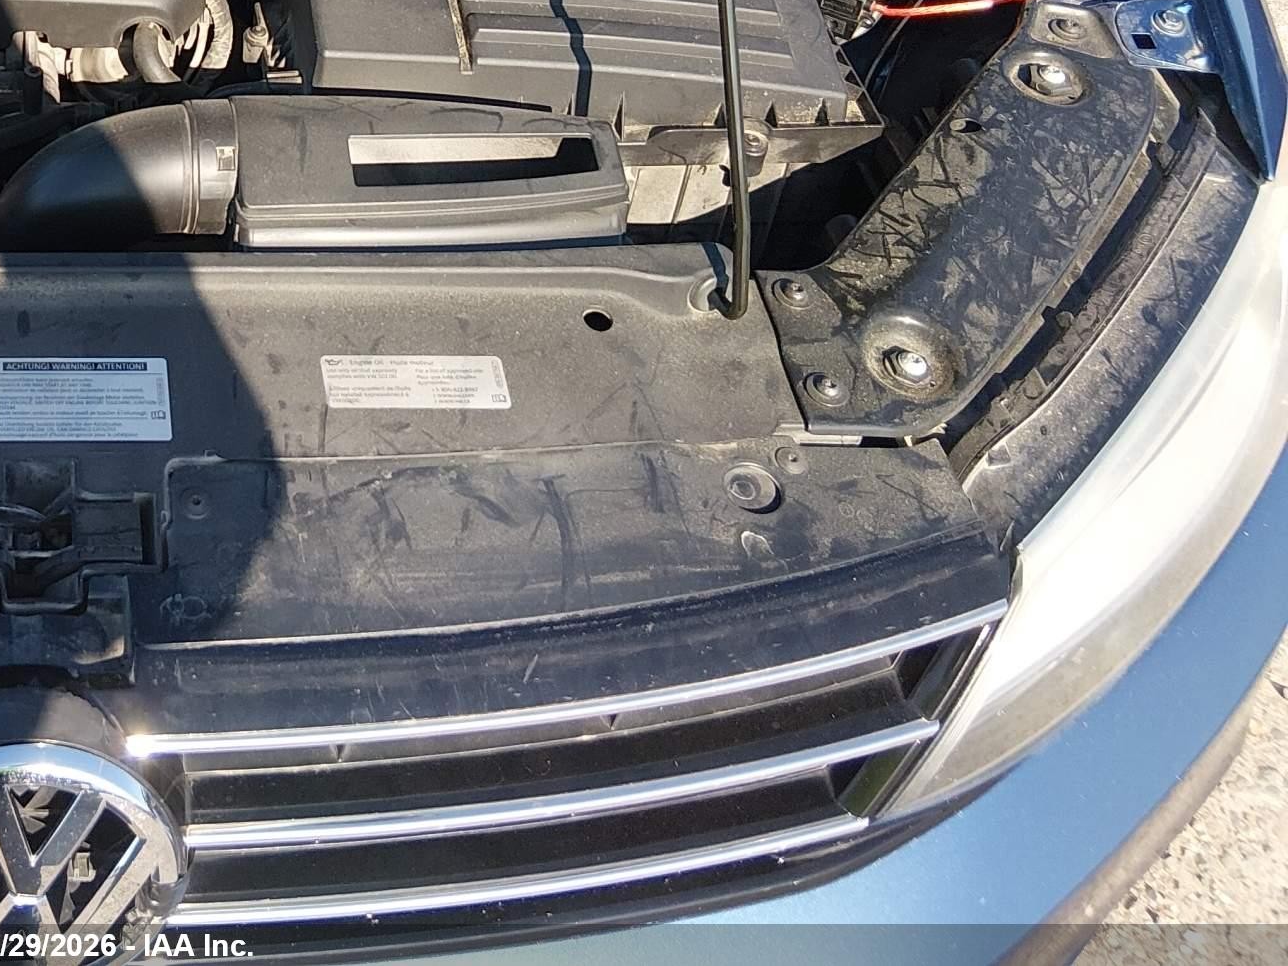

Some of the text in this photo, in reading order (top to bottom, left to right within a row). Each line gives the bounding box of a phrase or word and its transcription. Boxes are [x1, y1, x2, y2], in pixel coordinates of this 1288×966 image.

[5, 362, 145, 370] ACHTUNG! WARNING! ATTENTION!
